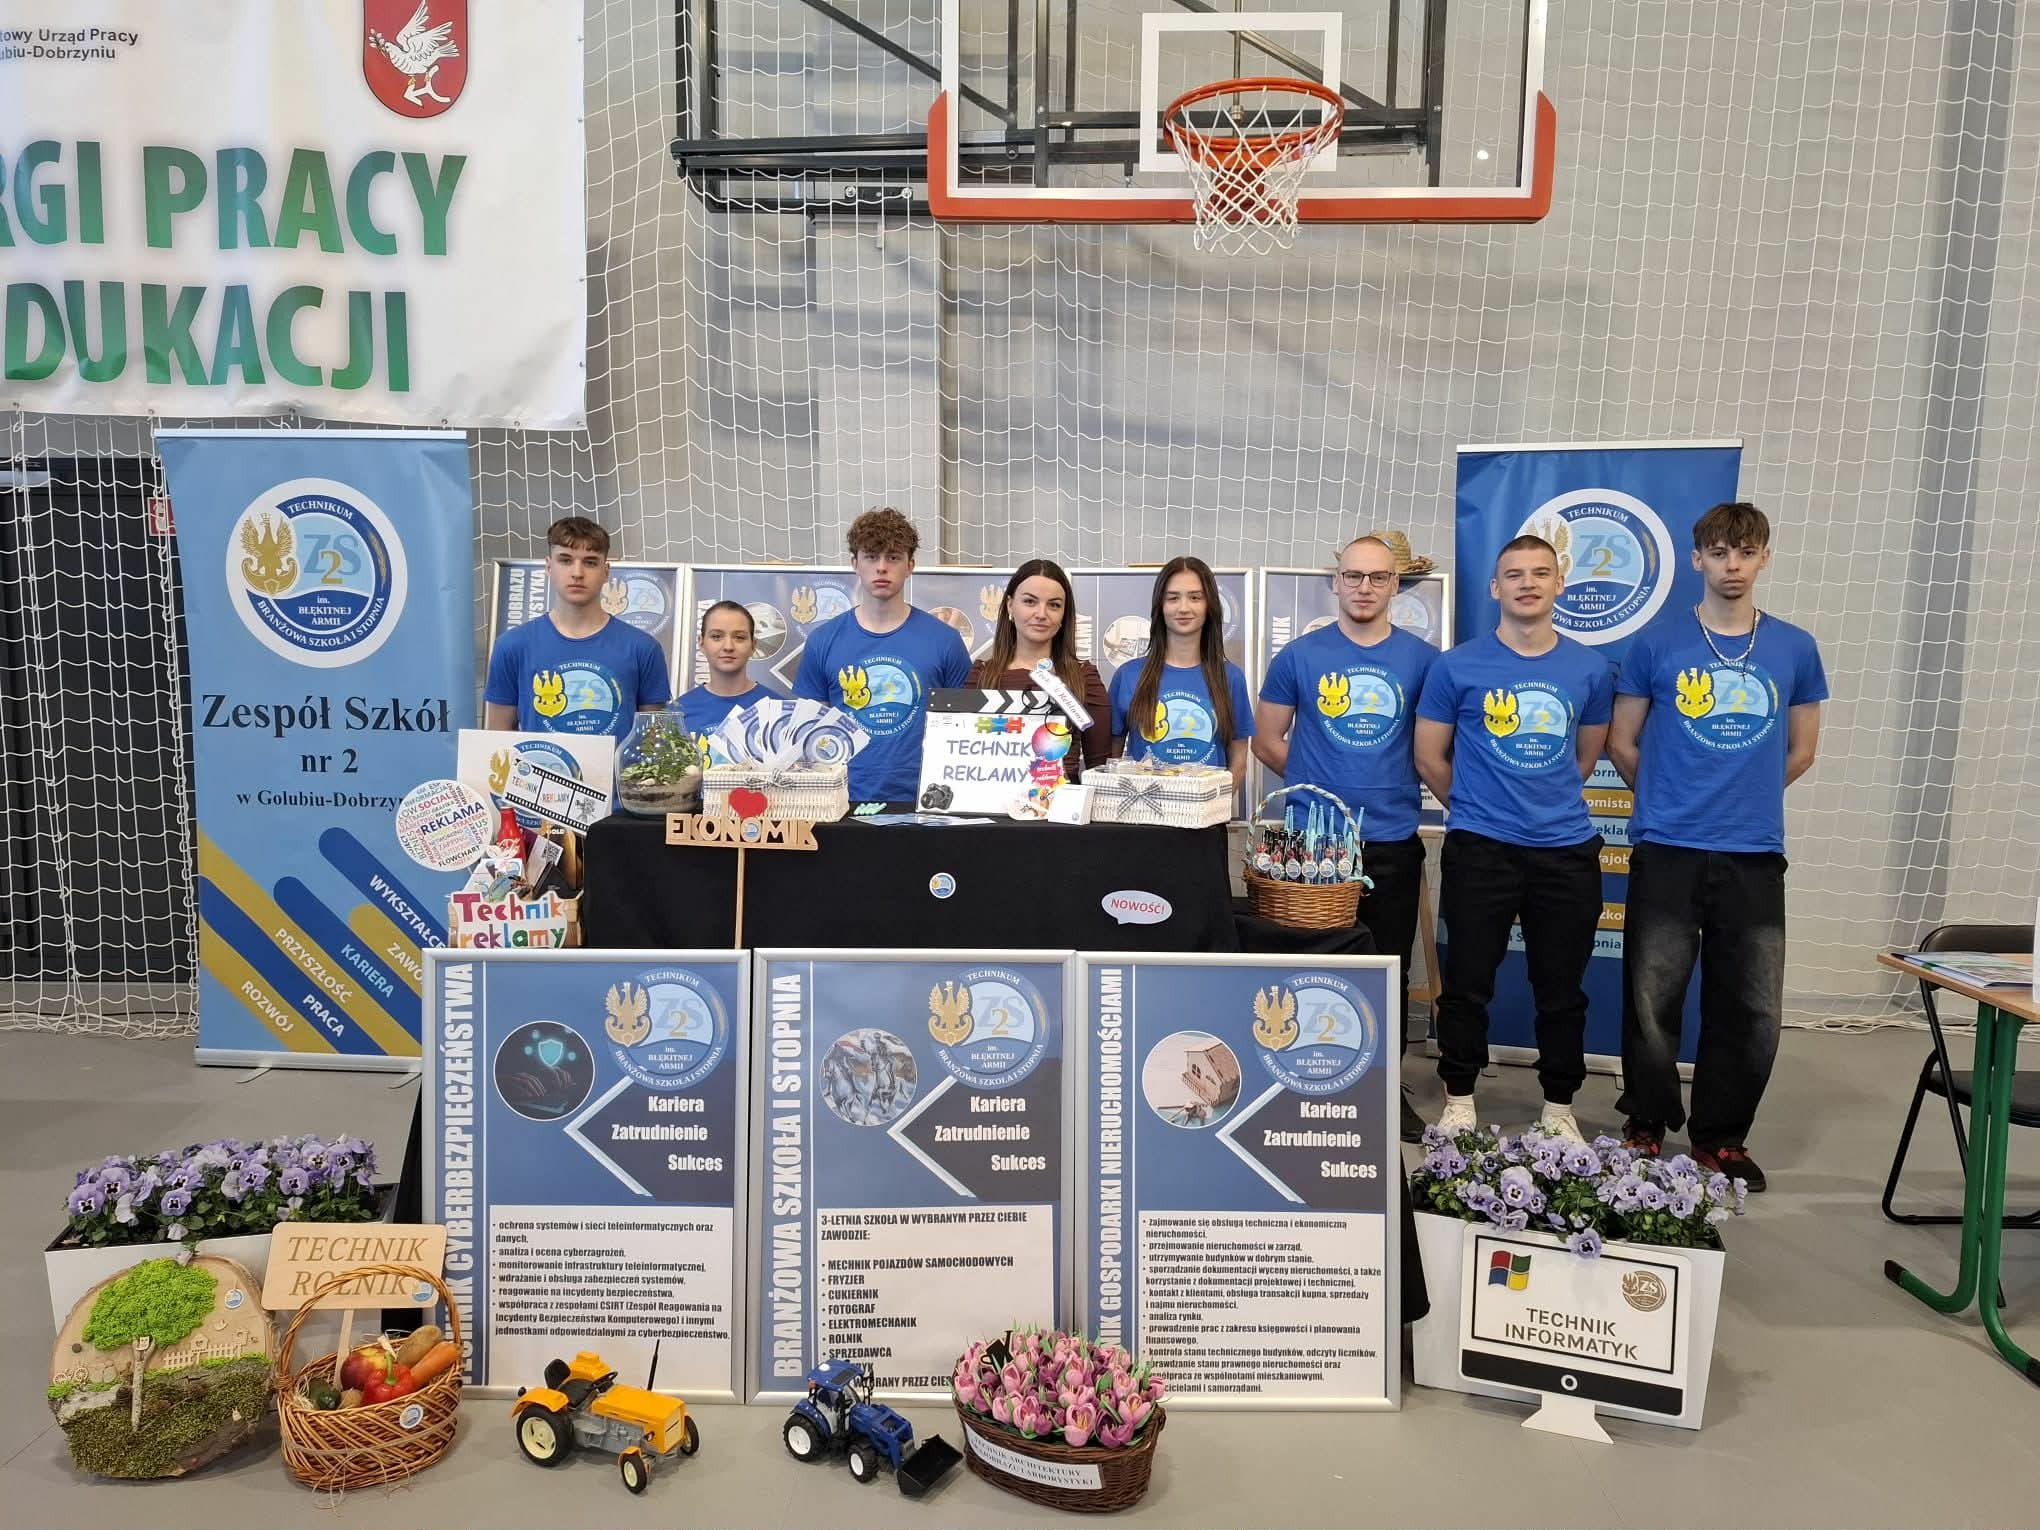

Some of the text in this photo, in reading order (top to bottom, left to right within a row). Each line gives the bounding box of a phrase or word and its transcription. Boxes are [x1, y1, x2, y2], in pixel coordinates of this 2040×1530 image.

[39, 28, 85, 45] Urząd
[90, 28, 138, 46] Pracy
[143, 145, 468, 256] PRACY
[4, 279, 411, 393] DUKACJI
[287, 500, 353, 520] TECHNIKUM
[1567, 506, 1629, 523] TECHNIKUM
[303, 534, 361, 576] ZS
[1575, 534, 1632, 569] ZS
[320, 550, 344, 585] 2
[1591, 547, 1613, 576] 2
[1567, 594, 1617, 603] BŁĘKITNEJ
[1573, 585, 1651, 628] SZKOŁA STOPNIA
[1578, 603, 1606, 611] ARMII
[298, 606, 352, 616] BŁĘKITNEJ
[257, 597, 385, 647] BRANŻOWA SZKOŁA STOPNIA
[311, 617, 341, 626] ARMII
[558, 661, 601, 671] TECHNIKUM
[863, 656, 902, 665] TECHNIKUM
[1346, 667, 1388, 677] TECHNIKUM
[1514, 681, 1558, 693] TECHNIKUM
[1729, 688, 1748, 712] 2
[201, 694, 451, 738] Zespół Szkół
[520, 743, 563, 755] TECHNIKUM
[946, 739, 1031, 758] TECHNIK
[301, 749, 359, 774] nr 2
[943, 765, 1030, 783] REKLAMY
[237, 794, 251, 804] w
[257, 790, 402, 811] Golubiu-Dobrzy
[418, 792, 453, 811] SOCIAL
[420, 801, 485, 836] REKLAMA
[666, 813, 818, 849] EKONOMIK
[453, 893, 563, 923] Technik
[459, 923, 565, 949] reklamy
[275, 928, 355, 1004] PRZYSZŁOŚĆ
[341, 944, 395, 998] KARIERA
[646, 971, 700, 987] TECHNIKUM
[966, 969, 1020, 985] TECHNIKUM
[1293, 976, 1348, 992] TECHNIKUM
[241, 979, 294, 1033] ROZWÓJ
[302, 993, 345, 1038] PRACA
[668, 1009, 689, 1037] 2
[991, 1008, 1009, 1035] 2
[1316, 1014, 1336, 1042] 2
[659, 1062, 684, 1070] ARMII
[981, 1061, 1006, 1069] ARMII
[1097, 968, 1122, 1174] NIERUCHOMOŚCIAMI
[1307, 1067, 1332, 1075] ARMII
[648, 1096, 705, 1113] Kariera
[970, 1096, 1026, 1113] Kariera
[1300, 1101, 1358, 1119] Kariera
[440, 963, 474, 1271] CYBERBEZPIECZEŃSTWA
[611, 1124, 709, 1141] Zatrudnienie
[934, 1125, 1030, 1142] Zatrudnienie
[1263, 1130, 1361, 1148] Zatrudnienie
[667, 1154, 723, 1171] Sukces
[991, 1154, 1046, 1171] Sukces
[1321, 1161, 1377, 1178] Sukces
[768, 974, 802, 1377] BRANŻOWA SZKOŁA I STOPNIA
[499, 1221, 534, 1230] ochrona
[536, 1221, 579, 1231] systemów
[607, 1221, 694, 1232] teleinformatycznych
[696, 1223, 713, 1231] oraz
[821, 1211, 1027, 1226] 3-LETNIA SZKOŁA W WYBRANYM PRZEZ CIEBIE
[821, 1230, 870, 1241] ZAWODZIE:
[287, 1237, 428, 1262] TECHNIK
[499, 1247, 529, 1256] analiza
[1100, 1179, 1122, 1311] GOSPODARKI
[499, 1261, 563, 1270] monitorowanie
[565, 1261, 623, 1271] infrastruktury
[828, 1256, 1014, 1270] MECHNIK POJAZDÓW SAMOCHODOWYCH
[1149, 1254, 1204, 1262] utrzymywanie
[1206, 1254, 1246, 1262] budynków
[1255, 1254, 1285, 1263] dobrym
[499, 1274, 542, 1283] wdrażanie
[828, 1274, 865, 1285] FRYZJER
[499, 1287, 549, 1296] reagowanie
[828, 1288, 879, 1300] CUKIERNIK
[1149, 1288, 1179, 1297] kontakt
[1260, 1289, 1300, 1299] transakcji
[1330, 1291, 1369, 1300] sprzedaży
[1638, 1280, 1658, 1295] ZS
[499, 1300, 548, 1309] współpraca
[555, 1301, 598, 1310] zespołami
[600, 1301, 624, 1310] CSIRT
[658, 1302, 710, 1312] Reagowania
[712, 1303, 722, 1312] na
[828, 1303, 876, 1315] FOTOGRAF
[686, 1316, 714, 1326] innymi
[828, 1317, 917, 1329] ELEKTROMECHANIK
[1149, 1312, 1177, 1320] analiza
[1526, 1307, 1617, 1337] TECHNIK
[496, 1327, 548, 1336] jednostkami
[550, 1327, 626, 1337] odpowiedzialnymi
[828, 1334, 863, 1344] ROLNIK
[1505, 1323, 1639, 1361] INFORMATYK
[828, 1347, 892, 1359] SPRZEDAWCA
[902, 1376, 929, 1387] PRZEZ
